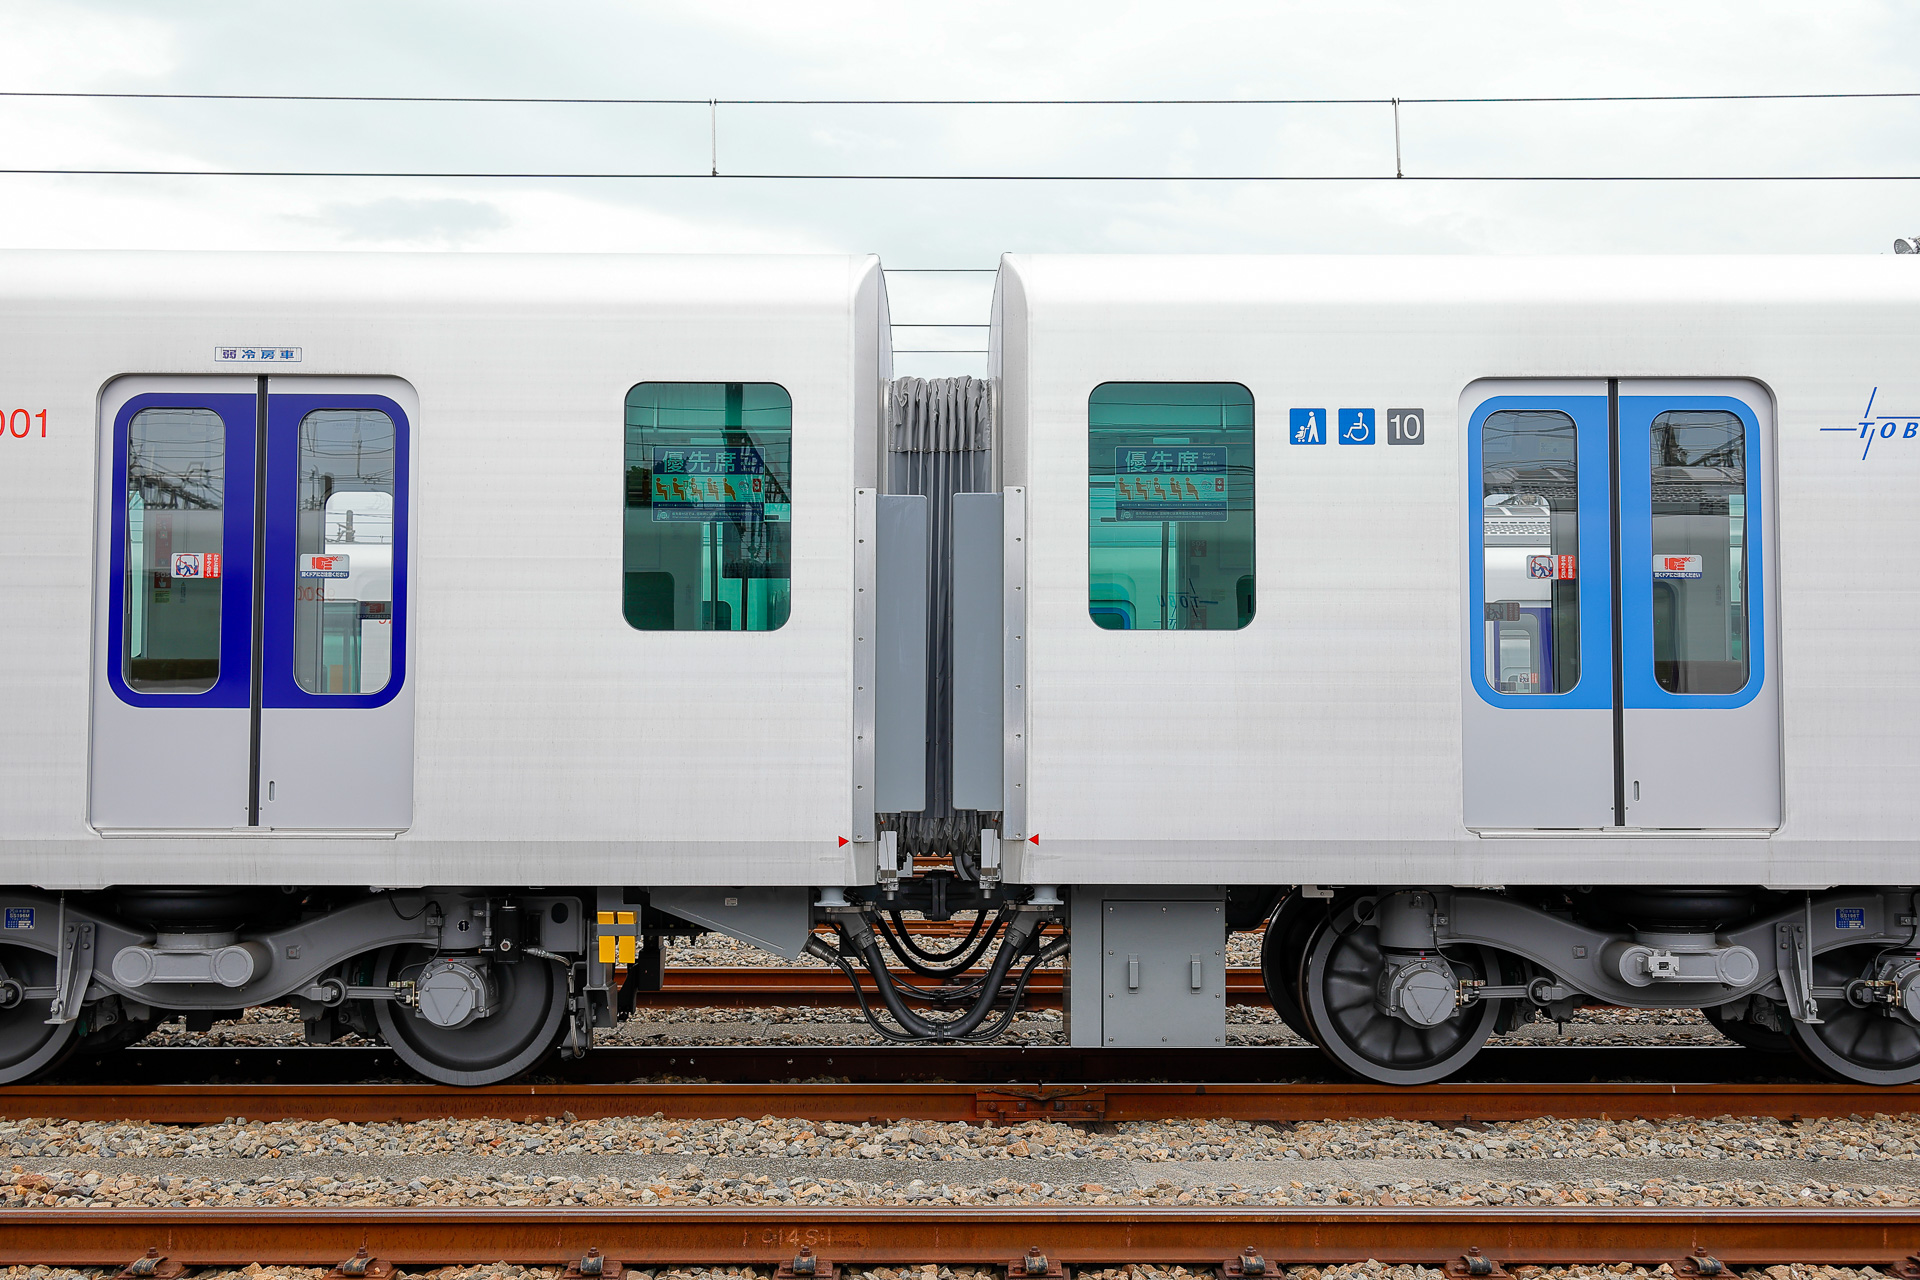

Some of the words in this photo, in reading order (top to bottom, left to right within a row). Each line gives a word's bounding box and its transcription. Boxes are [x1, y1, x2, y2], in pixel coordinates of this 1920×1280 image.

[222, 349, 294, 359] 弱冷房車
[0, 408, 46, 438] 01
[1390, 414, 1421, 440] 10
[662, 450, 736, 473] 優先席
[1125, 450, 1199, 473] 優先席
[461, 921, 466, 930] 1
